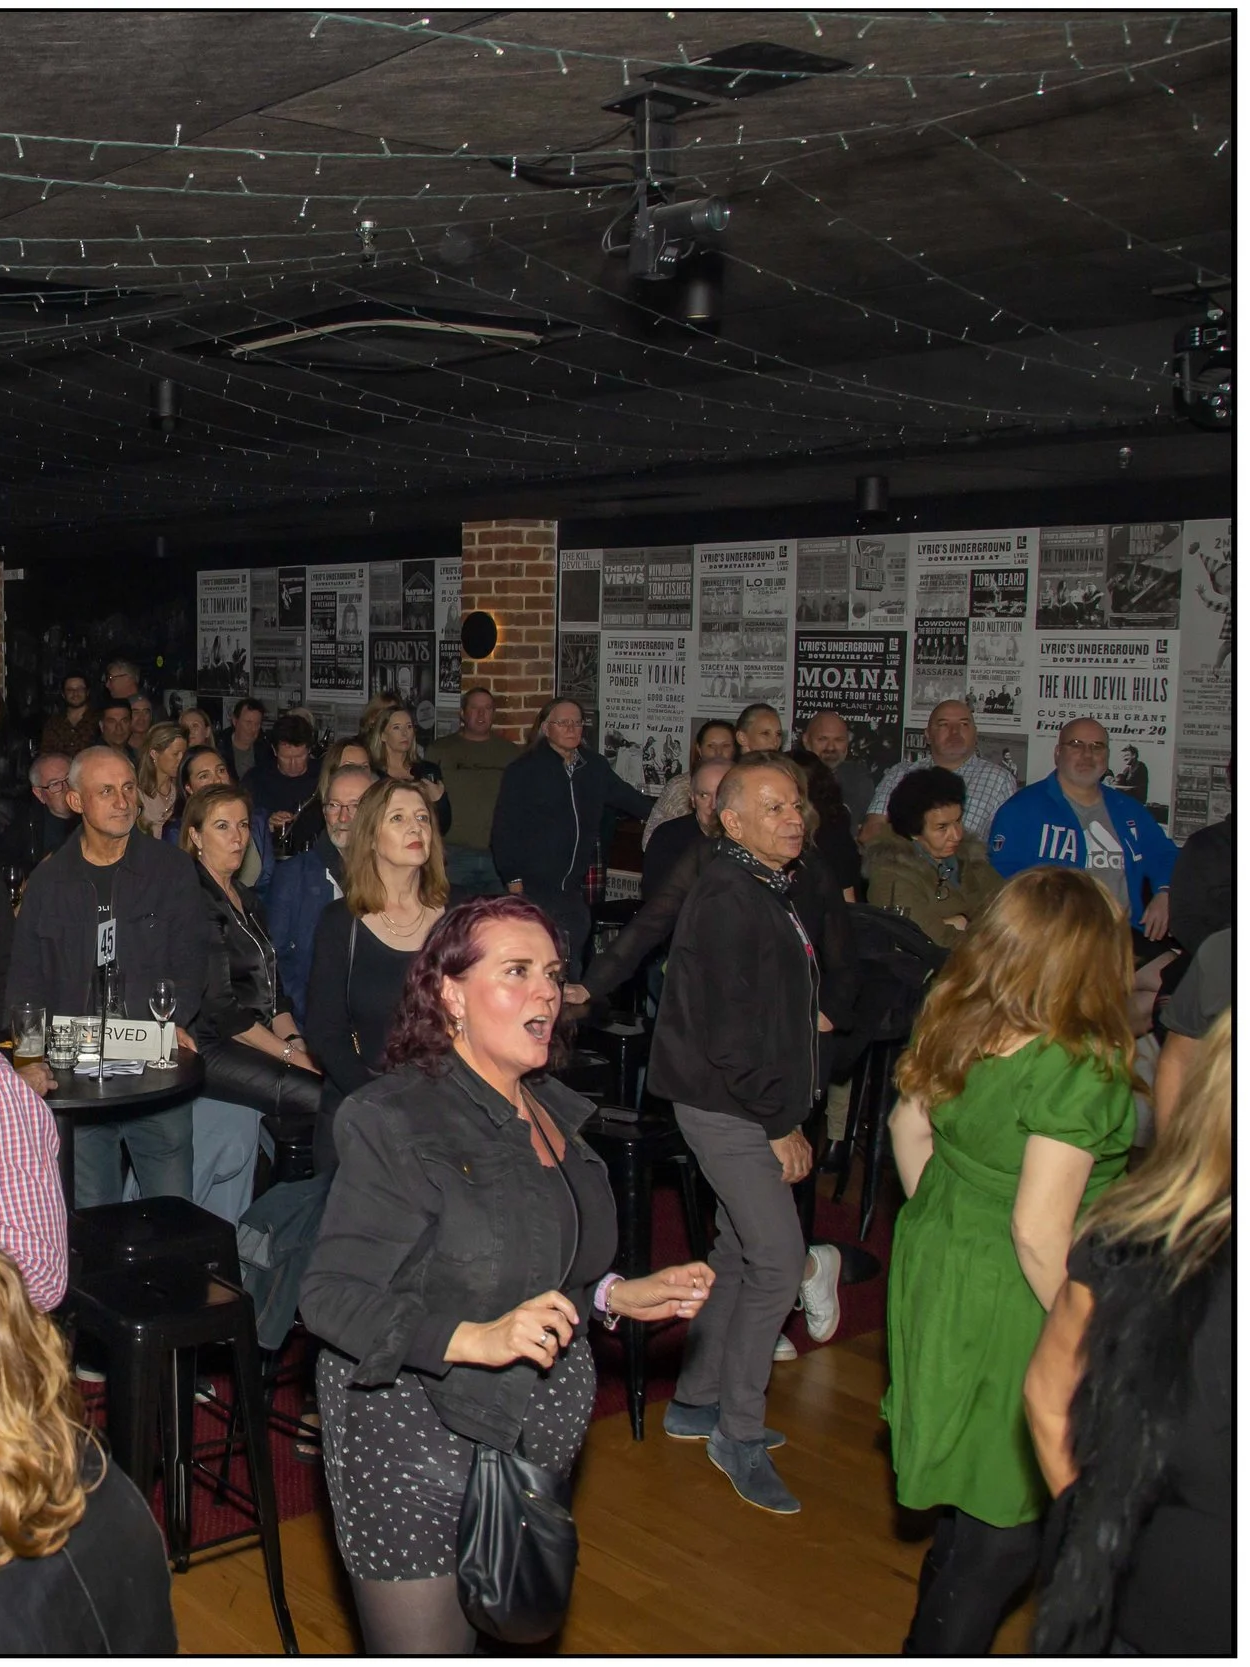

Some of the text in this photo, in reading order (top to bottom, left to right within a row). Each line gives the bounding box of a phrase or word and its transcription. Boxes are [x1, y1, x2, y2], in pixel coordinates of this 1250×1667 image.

[918, 542, 1011, 555] LYRIC'S UNDERGROUND
[701, 551, 775, 563] LYRIC'S UNDERGROUND
[604, 573, 644, 584] VIEWS
[998, 573, 1025, 586] BEARD
[649, 582, 663, 595] TOM
[664, 582, 691, 595] FISHER
[972, 621, 1023, 633] BAD NUTRITION
[607, 640, 674, 650] LYRIC'S UNDERGROUND
[799, 641, 884, 652] LYRIC'S UNDERGROUND
[1041, 643, 1149, 655] LYRIC'S UNDERGROUND
[606, 663, 643, 674] DANIELLE
[647, 664, 686, 685] YOKINE
[915, 668, 964, 677] SASSAFRAS
[609, 676, 639, 688] PONDER
[797, 667, 900, 690] MOANA
[1039, 675, 1060, 699] THE
[1063, 676, 1089, 700] KILL
[1093, 676, 1128, 701] DEVIL
[1132, 676, 1169, 702] HILLS
[665, 694, 686, 703] GRACE
[796, 690, 899, 702] BLACK STONE FROM THE SUN
[796, 710, 818, 720] Frid
[884, 714, 899, 724] 13
[1037, 709, 1077, 719] CUSS
[1124, 714, 1167, 723] GRANT
[605, 720, 641, 730] Fri Jan 17
[646, 723, 658, 731] Sat
[658, 724, 673, 733] Jan
[1036, 720, 1063, 731] Frid
[1148, 726, 1167, 736] 20
[1039, 823, 1078, 863] ITA
[1085, 848, 1125, 869] ida
[100, 926, 115, 958] 45
